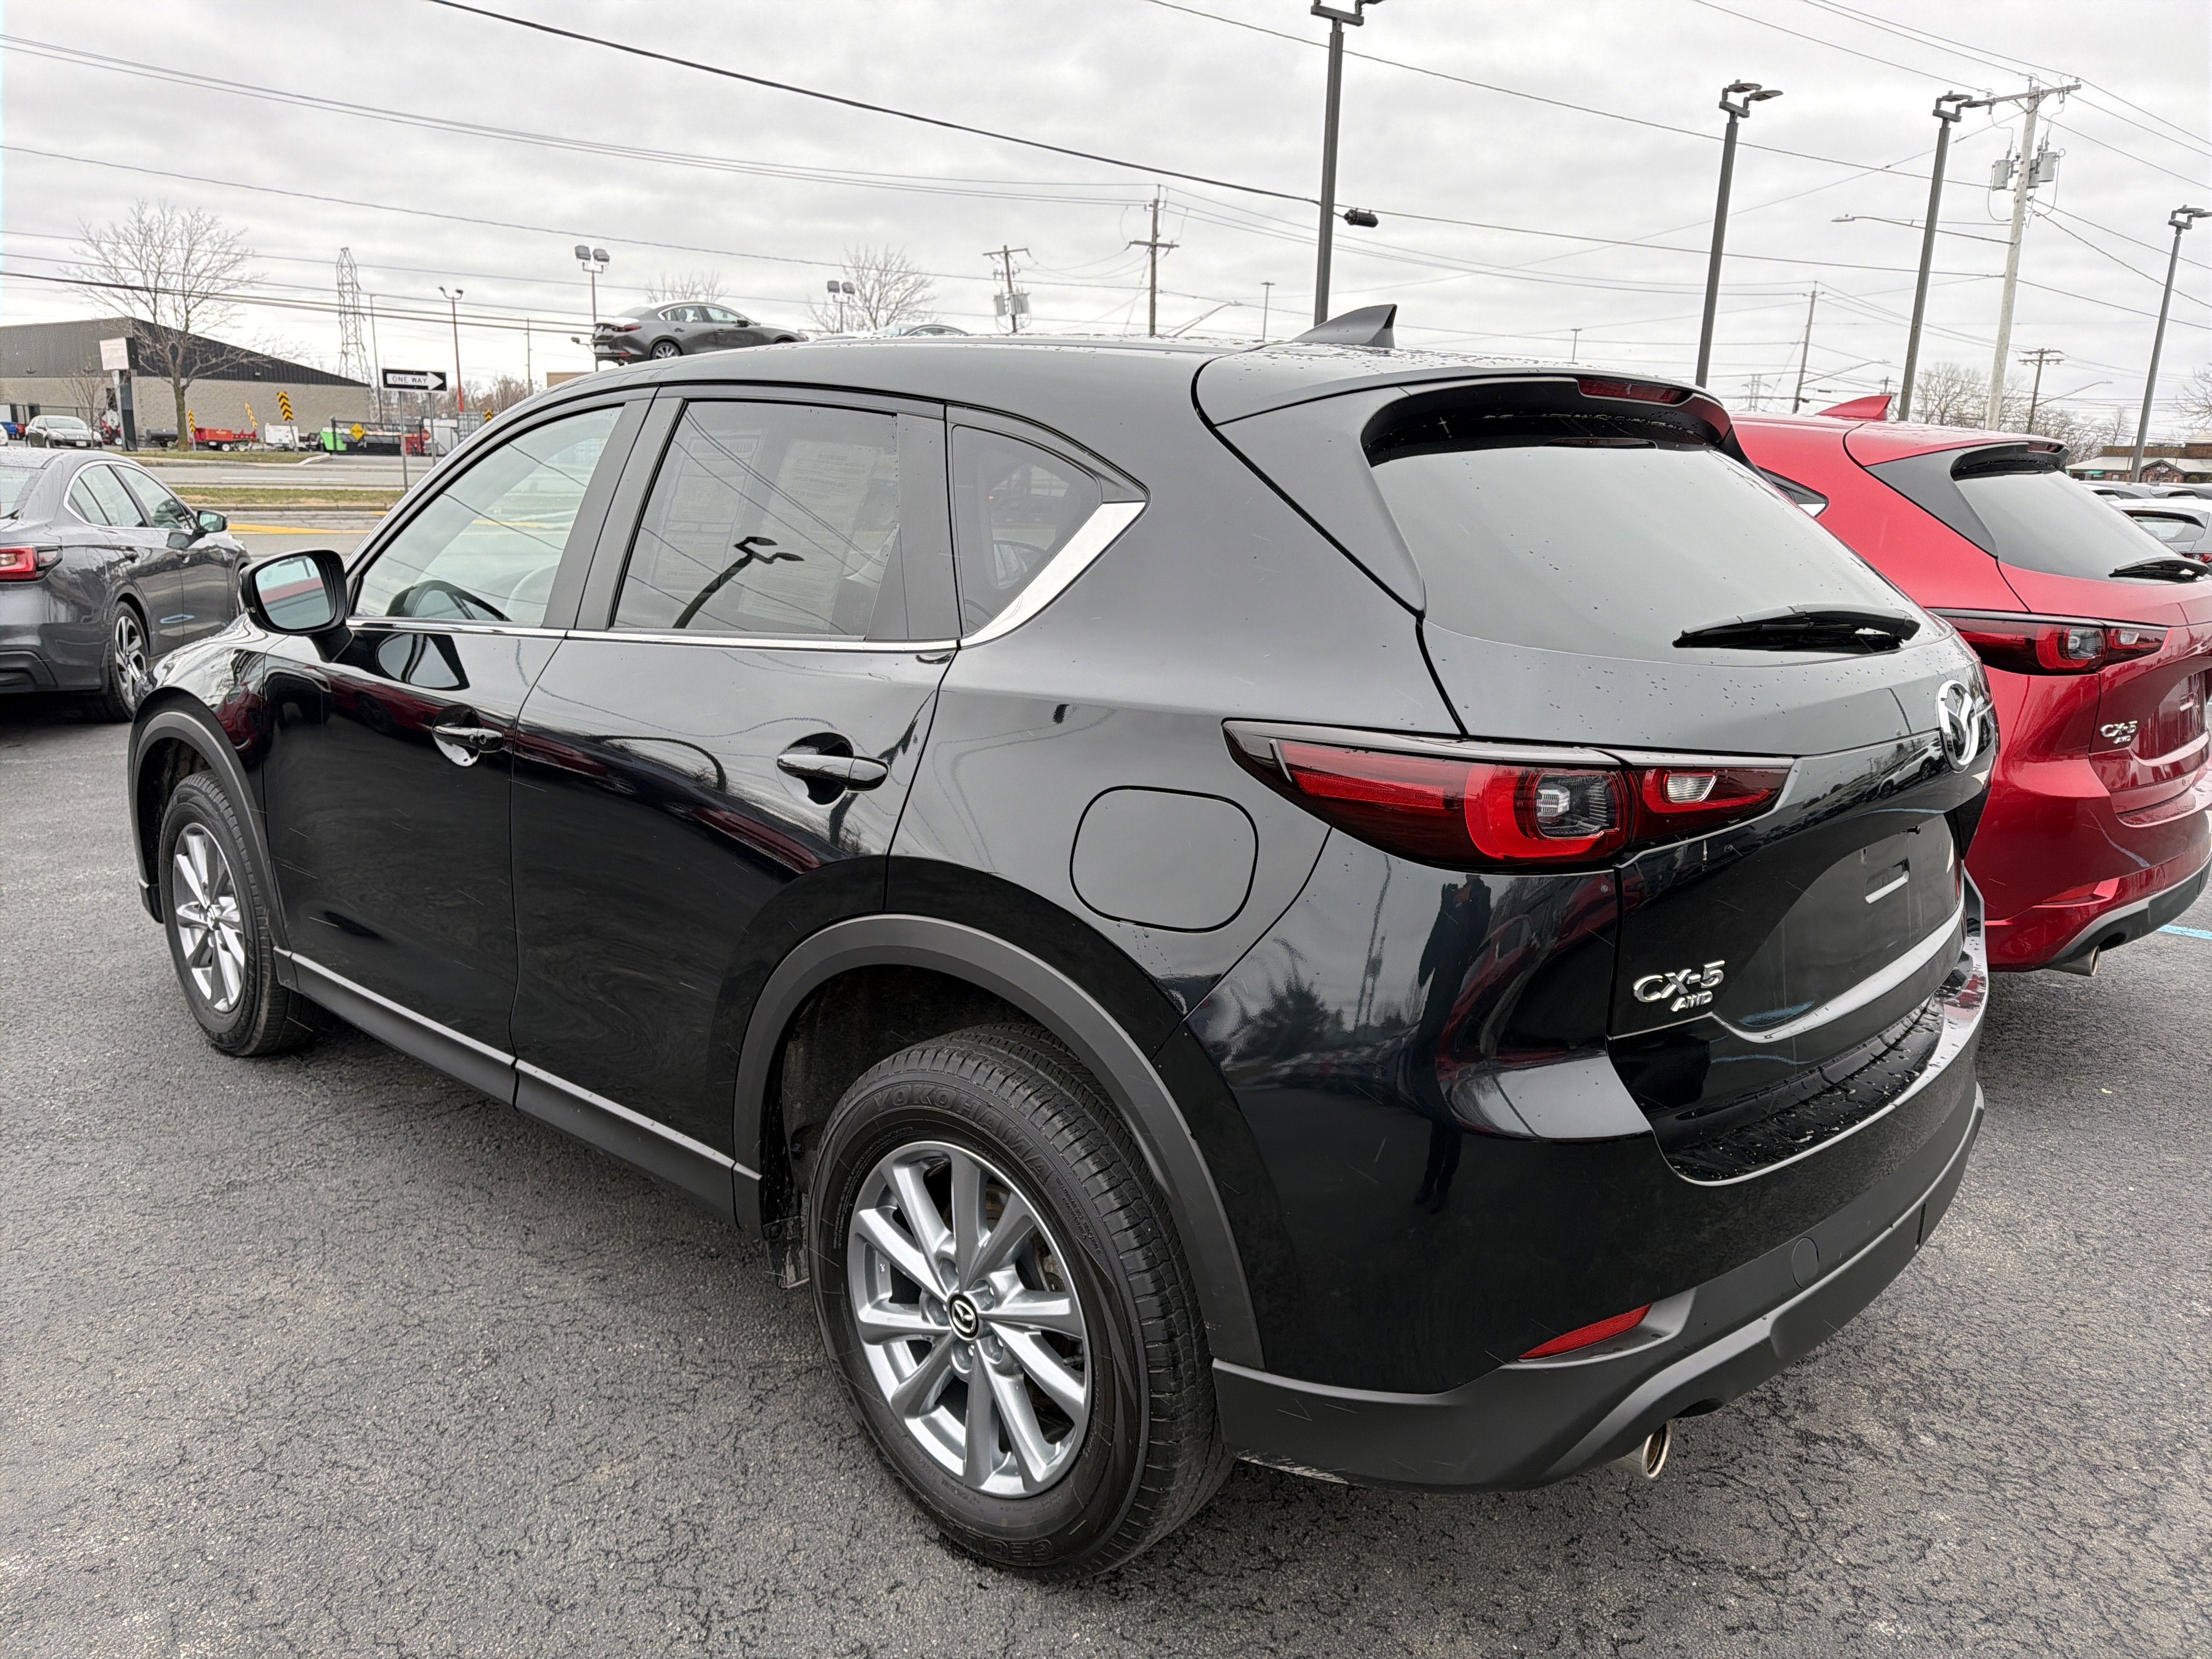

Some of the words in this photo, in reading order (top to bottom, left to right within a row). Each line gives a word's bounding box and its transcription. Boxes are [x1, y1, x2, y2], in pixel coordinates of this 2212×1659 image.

[2100, 720, 2138, 737] CX-5
[1633, 960, 1725, 1003] CX-5
[1669, 990, 1713, 1012] AWD
[873, 1084, 1054, 1185] YOKOHAMA
